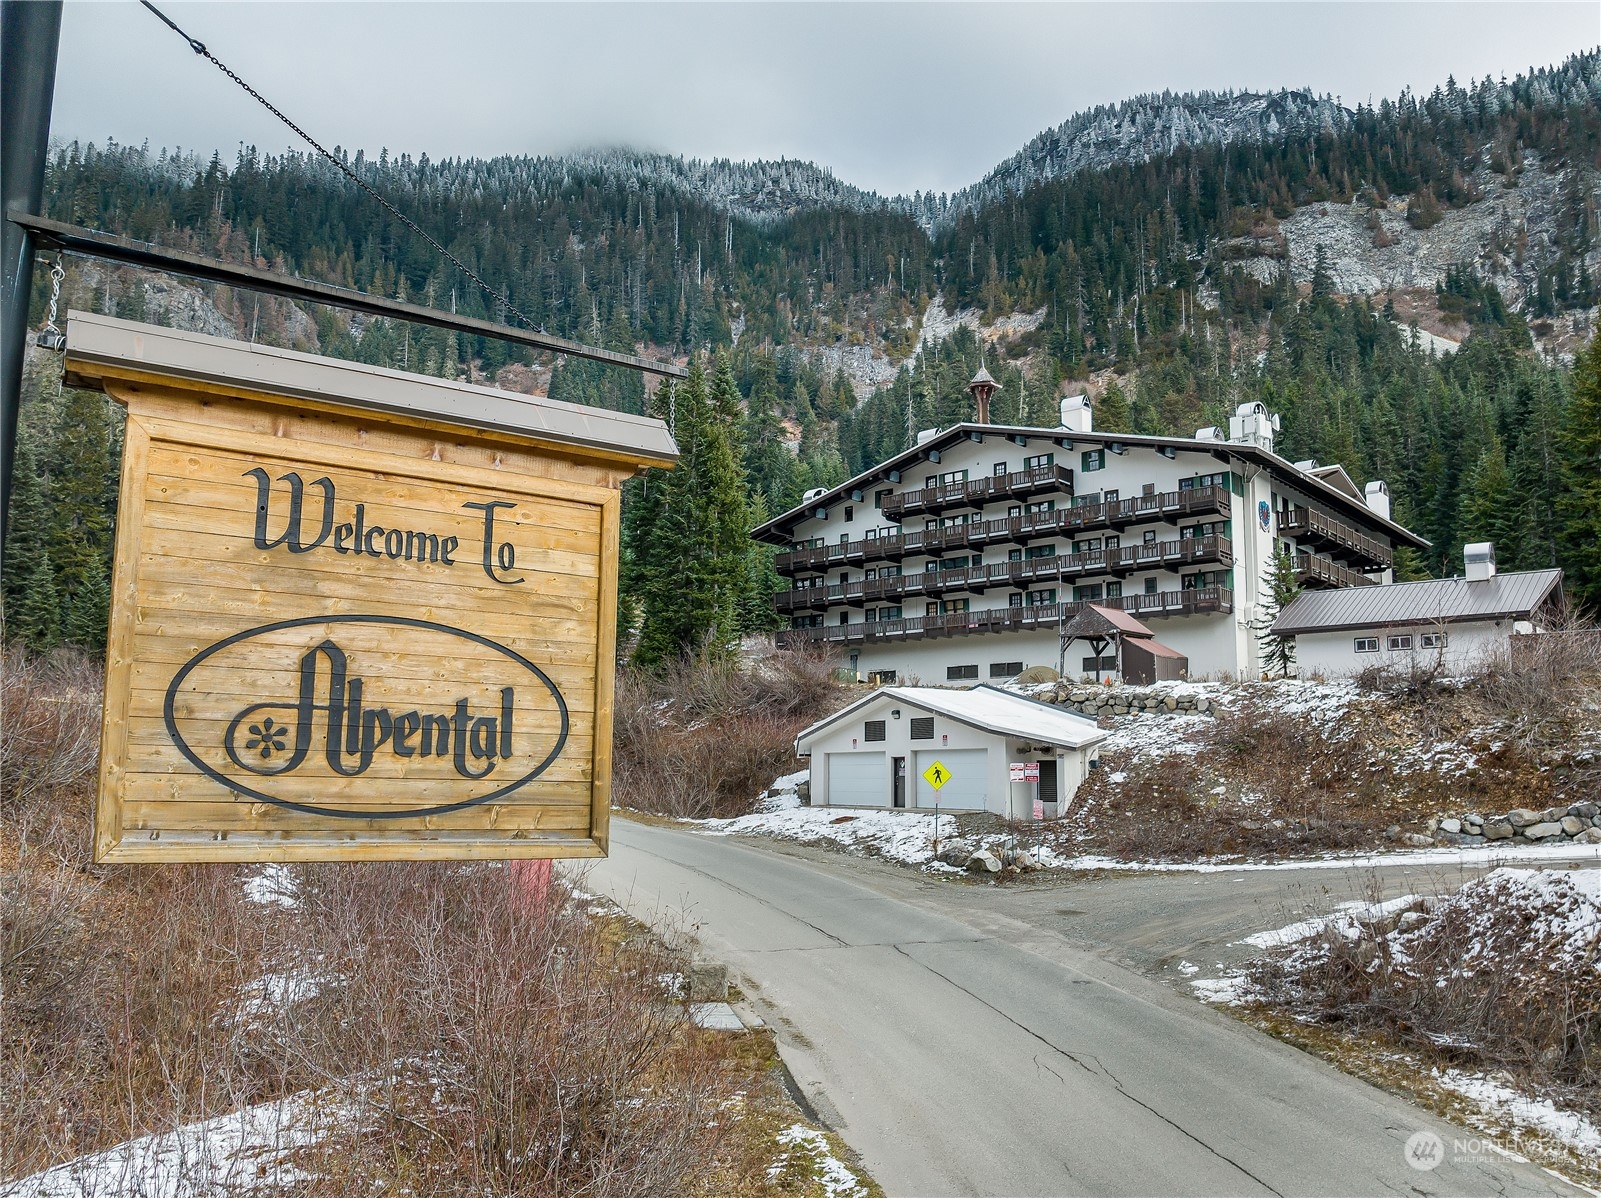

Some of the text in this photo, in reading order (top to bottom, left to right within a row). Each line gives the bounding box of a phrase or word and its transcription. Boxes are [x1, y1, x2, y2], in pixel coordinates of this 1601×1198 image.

[241, 467, 525, 584] Welcome To
[225, 639, 514, 778] Alpental
